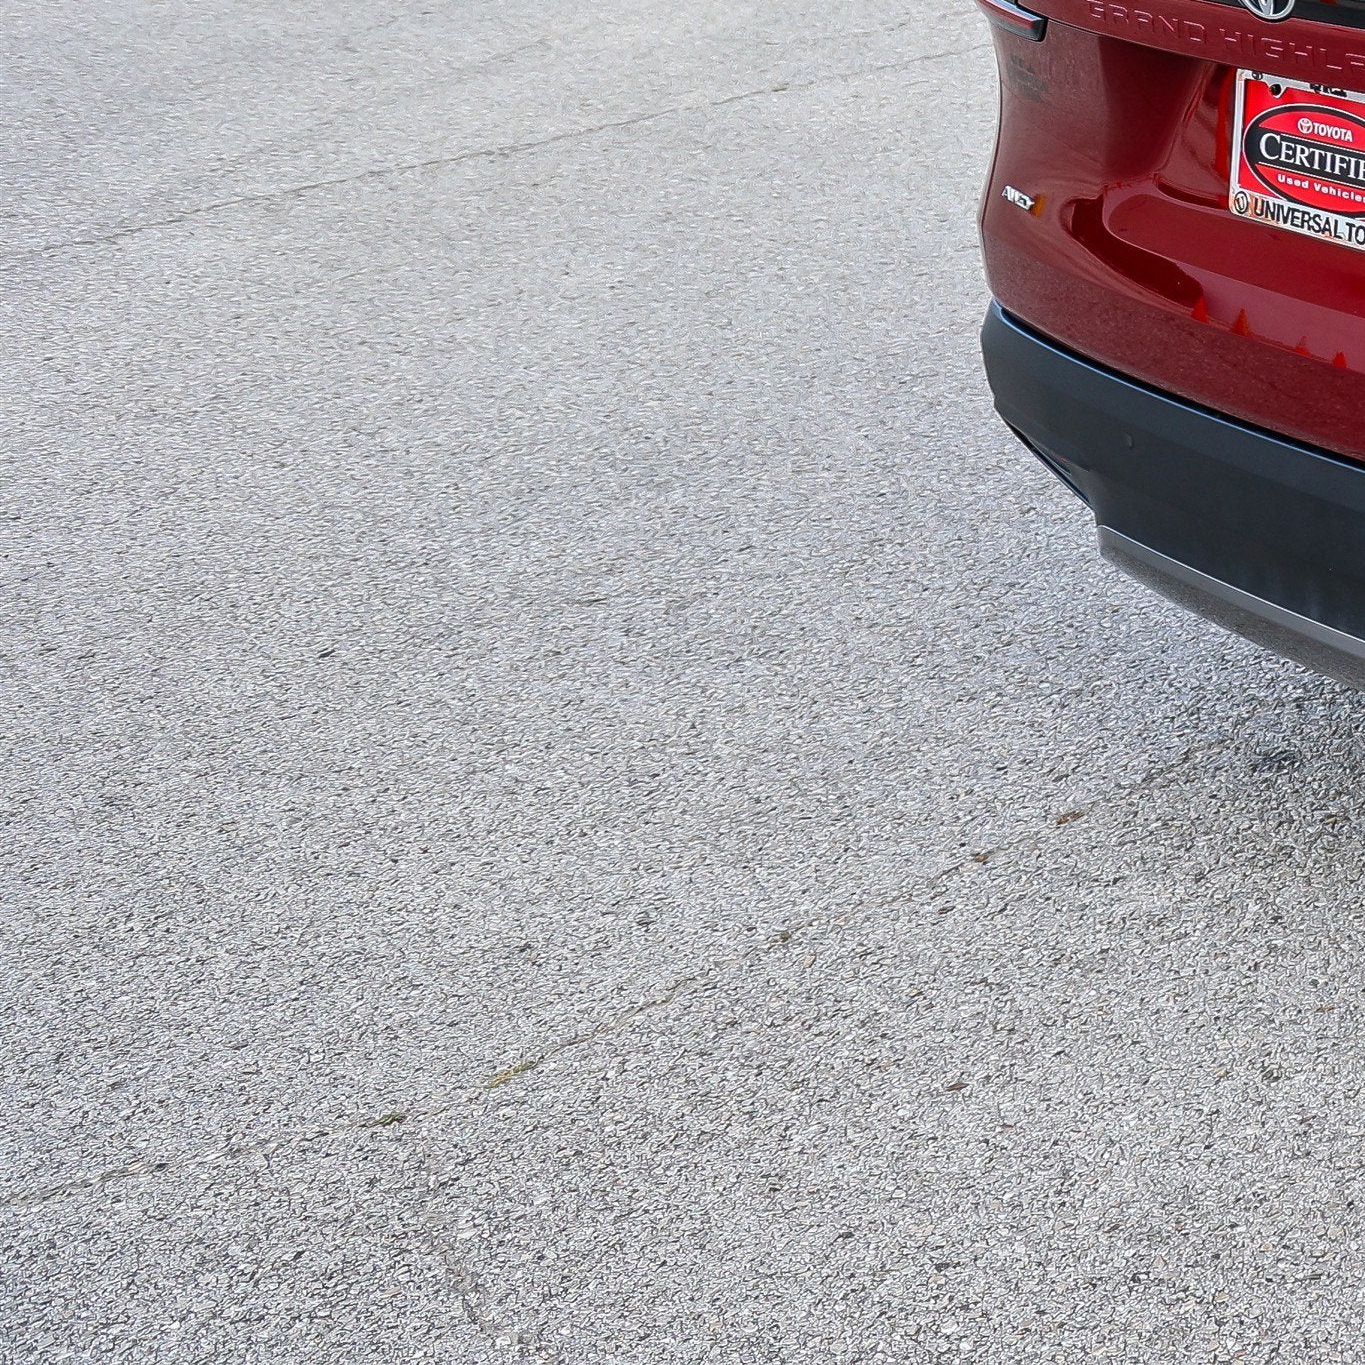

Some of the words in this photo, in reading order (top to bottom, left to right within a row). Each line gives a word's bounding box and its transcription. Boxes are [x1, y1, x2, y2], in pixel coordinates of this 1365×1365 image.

[1313, 122, 1353, 142] TOYOTA
[1277, 173, 1309, 189] Used
[1253, 197, 1343, 241] UNIVERSAL
